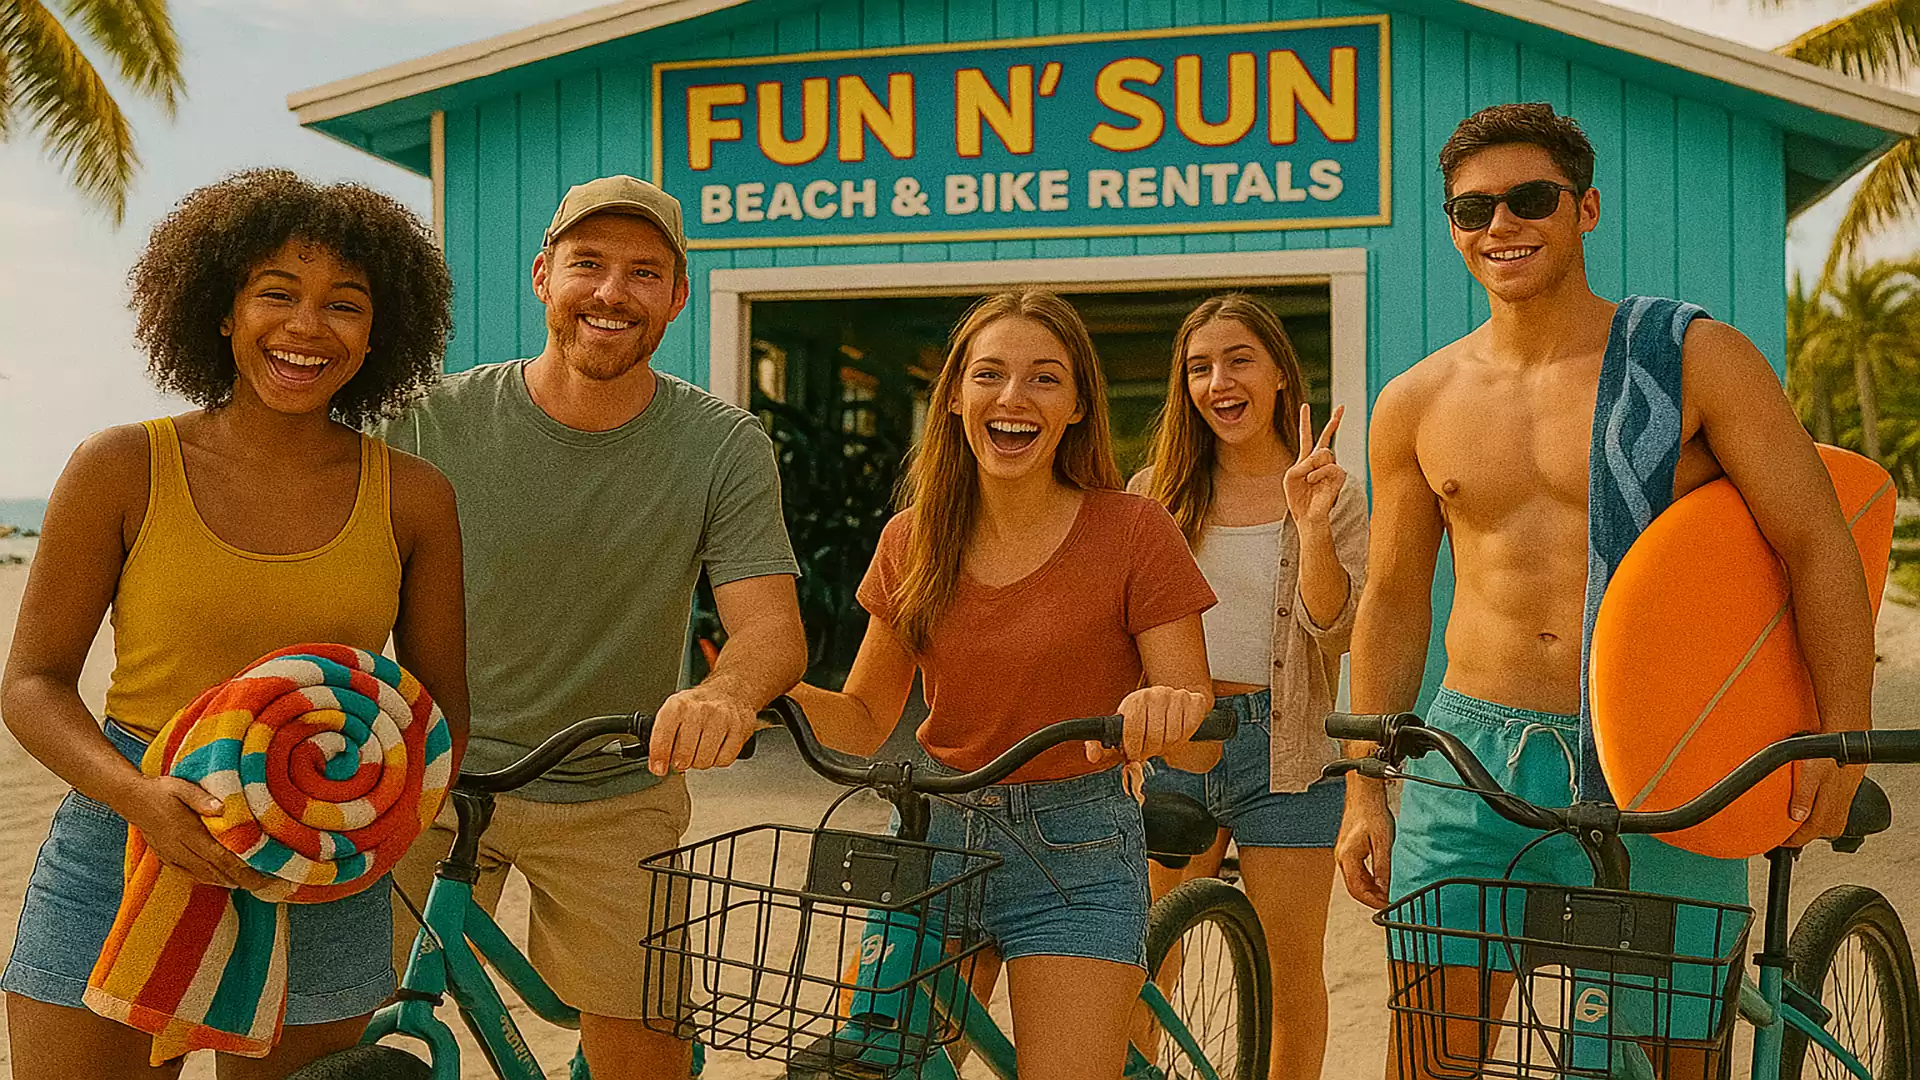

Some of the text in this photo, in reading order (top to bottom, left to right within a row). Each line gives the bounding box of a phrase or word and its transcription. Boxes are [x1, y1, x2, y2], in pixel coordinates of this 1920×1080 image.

[686, 46, 1358, 171] FUN N' SUN
[701, 160, 1343, 224] BEACH & BIKE RENTALS
